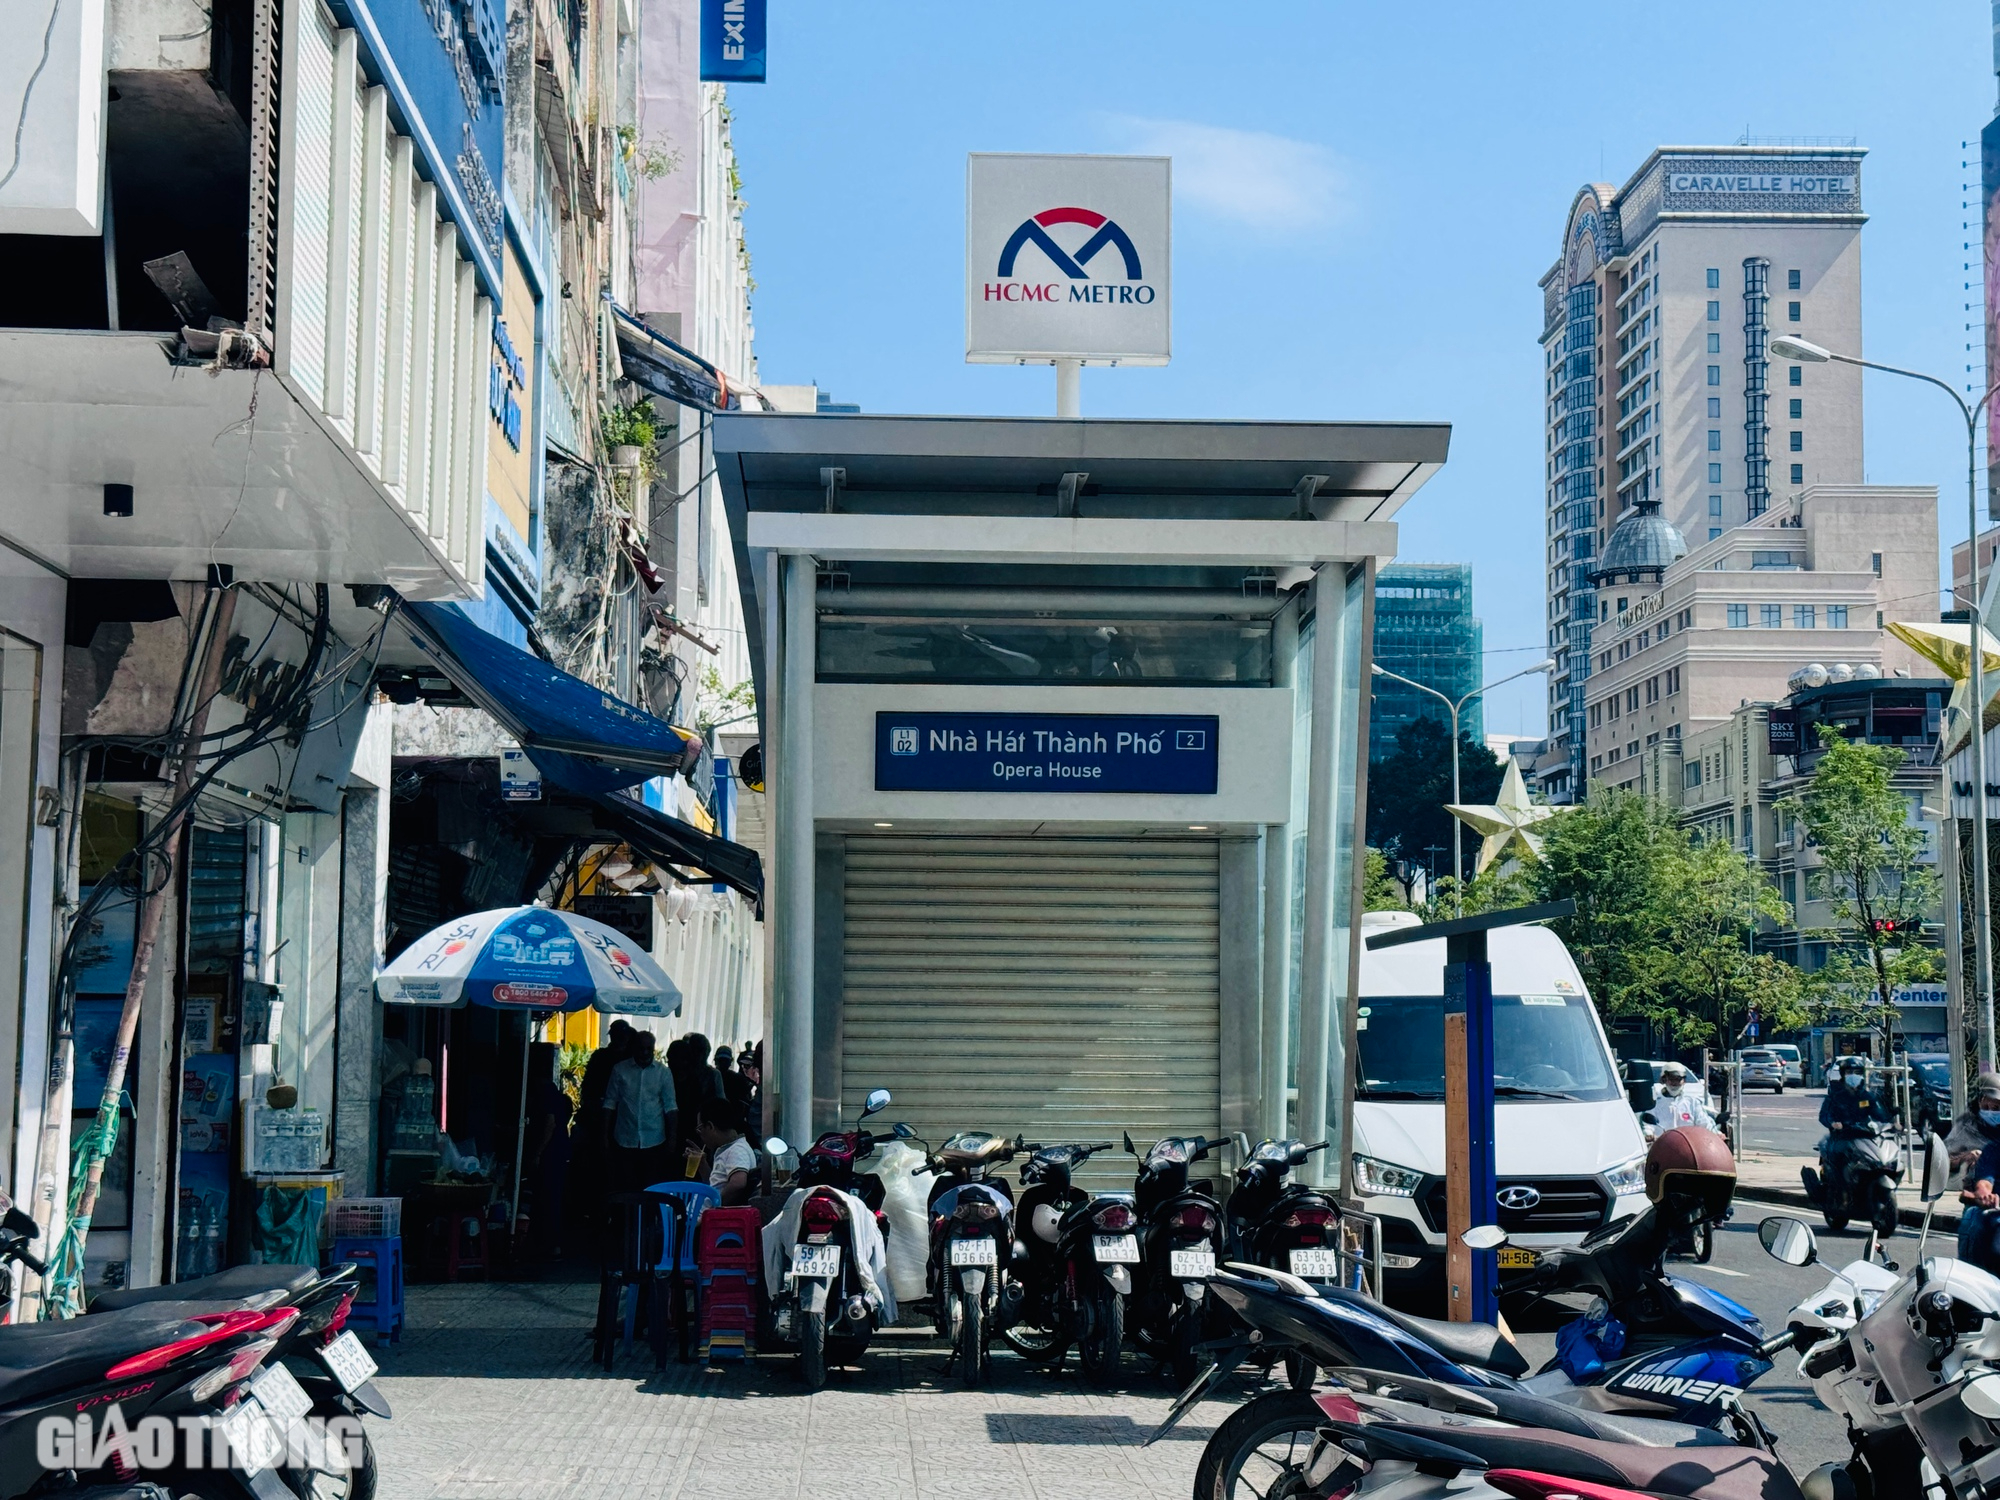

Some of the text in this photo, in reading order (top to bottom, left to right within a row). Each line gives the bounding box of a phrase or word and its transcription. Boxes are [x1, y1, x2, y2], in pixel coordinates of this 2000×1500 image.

[1675, 176, 1851, 193] CARAVELLE HOTEL
[984, 283, 1156, 305] HCMC METRO
[900, 730, 910, 739] L1
[1770, 722, 1795, 731] SKY
[897, 740, 912, 752] 02
[929, 729, 1195, 754] Nhà Hát Thành Phố 2
[993, 761, 1102, 781] Opera House
[449, 924, 479, 940] SA
[584, 930, 621, 948] SA
[417, 953, 448, 972] RI
[610, 963, 642, 985] RI
[954, 1252, 993, 1264] 036.66
[795, 1262, 836, 1275] 469.26
[1173, 1264, 1213, 1276] 937.59
[1293, 1263, 1334, 1276] 882.83
[1621, 1373, 1745, 1410] WINNER
